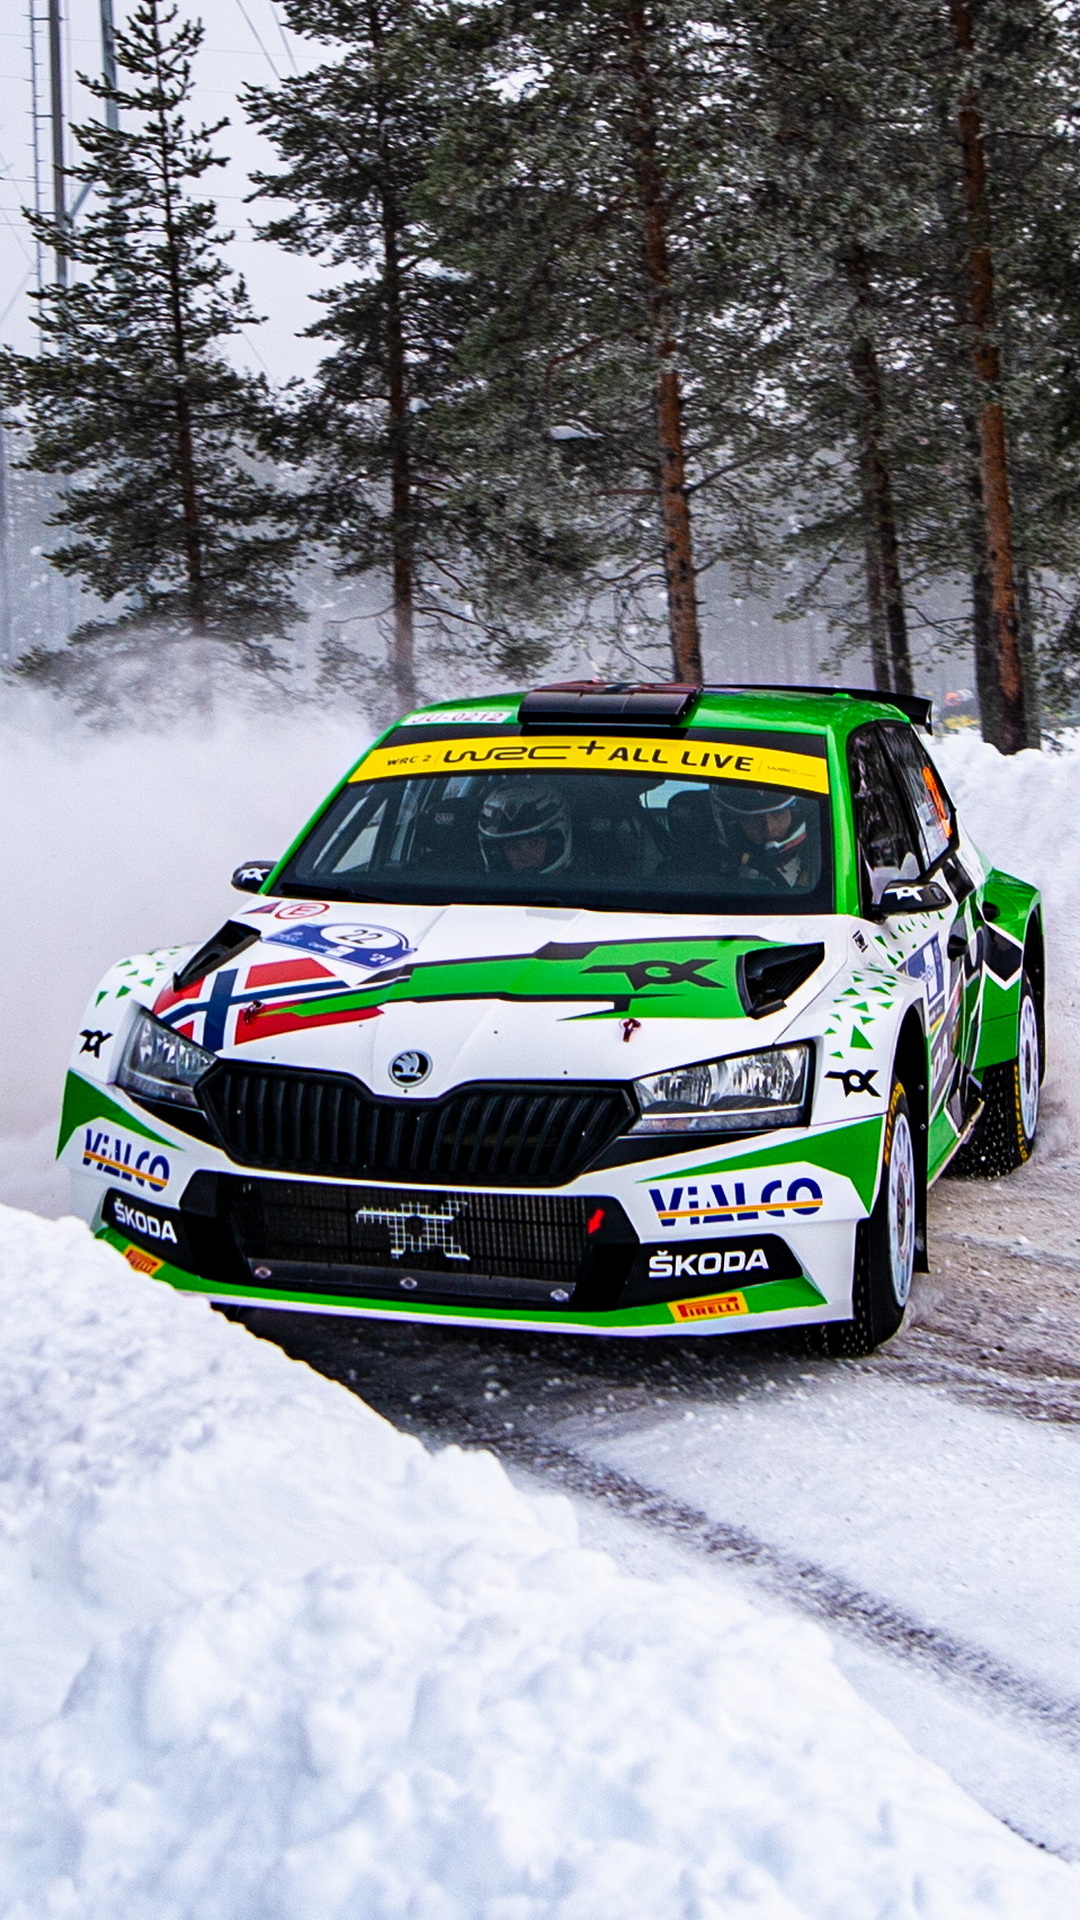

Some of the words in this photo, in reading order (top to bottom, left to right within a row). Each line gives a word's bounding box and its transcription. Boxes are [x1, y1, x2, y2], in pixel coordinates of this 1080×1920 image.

[387, 756, 419, 766] WRC
[422, 754, 432, 763] 2
[607, 746, 669, 763] ALL
[680, 750, 755, 772] LIVE
[338, 928, 383, 945] 22
[114, 1197, 178, 1244] ŠKODA
[648, 1248, 770, 1278] ŠKODA
[677, 1296, 740, 1318] PIRELLI
